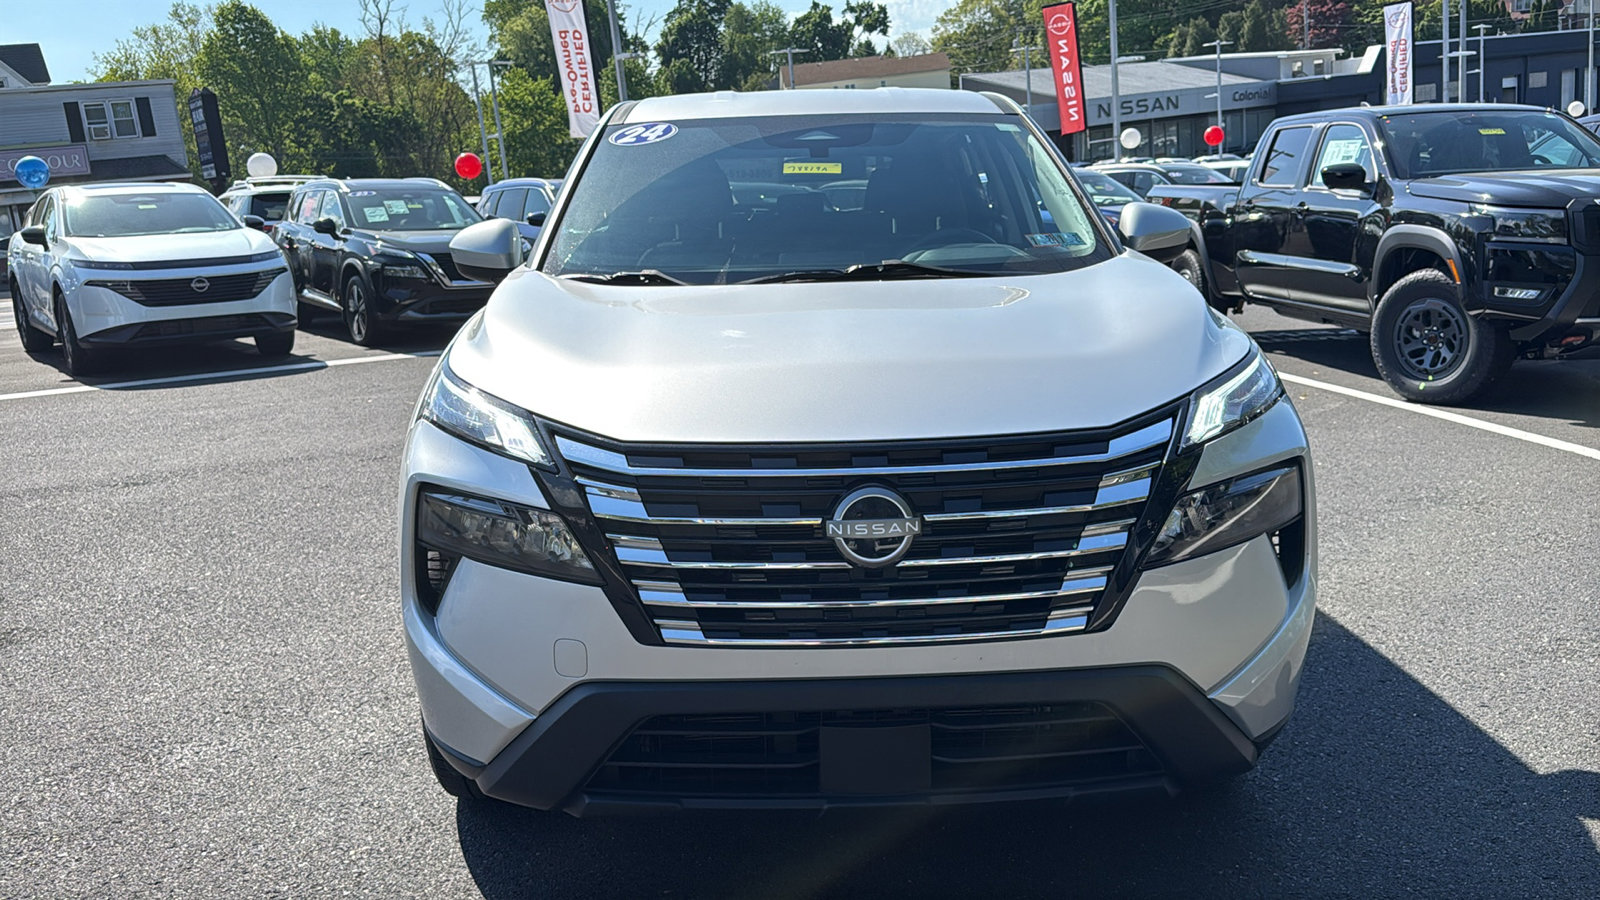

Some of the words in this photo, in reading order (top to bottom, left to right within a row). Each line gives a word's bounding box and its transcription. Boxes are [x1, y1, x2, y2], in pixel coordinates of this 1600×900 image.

[1232, 87, 1272, 102] Colonial
[1097, 95, 1179, 118] NSSAN
[616, 124, 669, 144] 24
[829, 521, 919, 535] NISSAN
